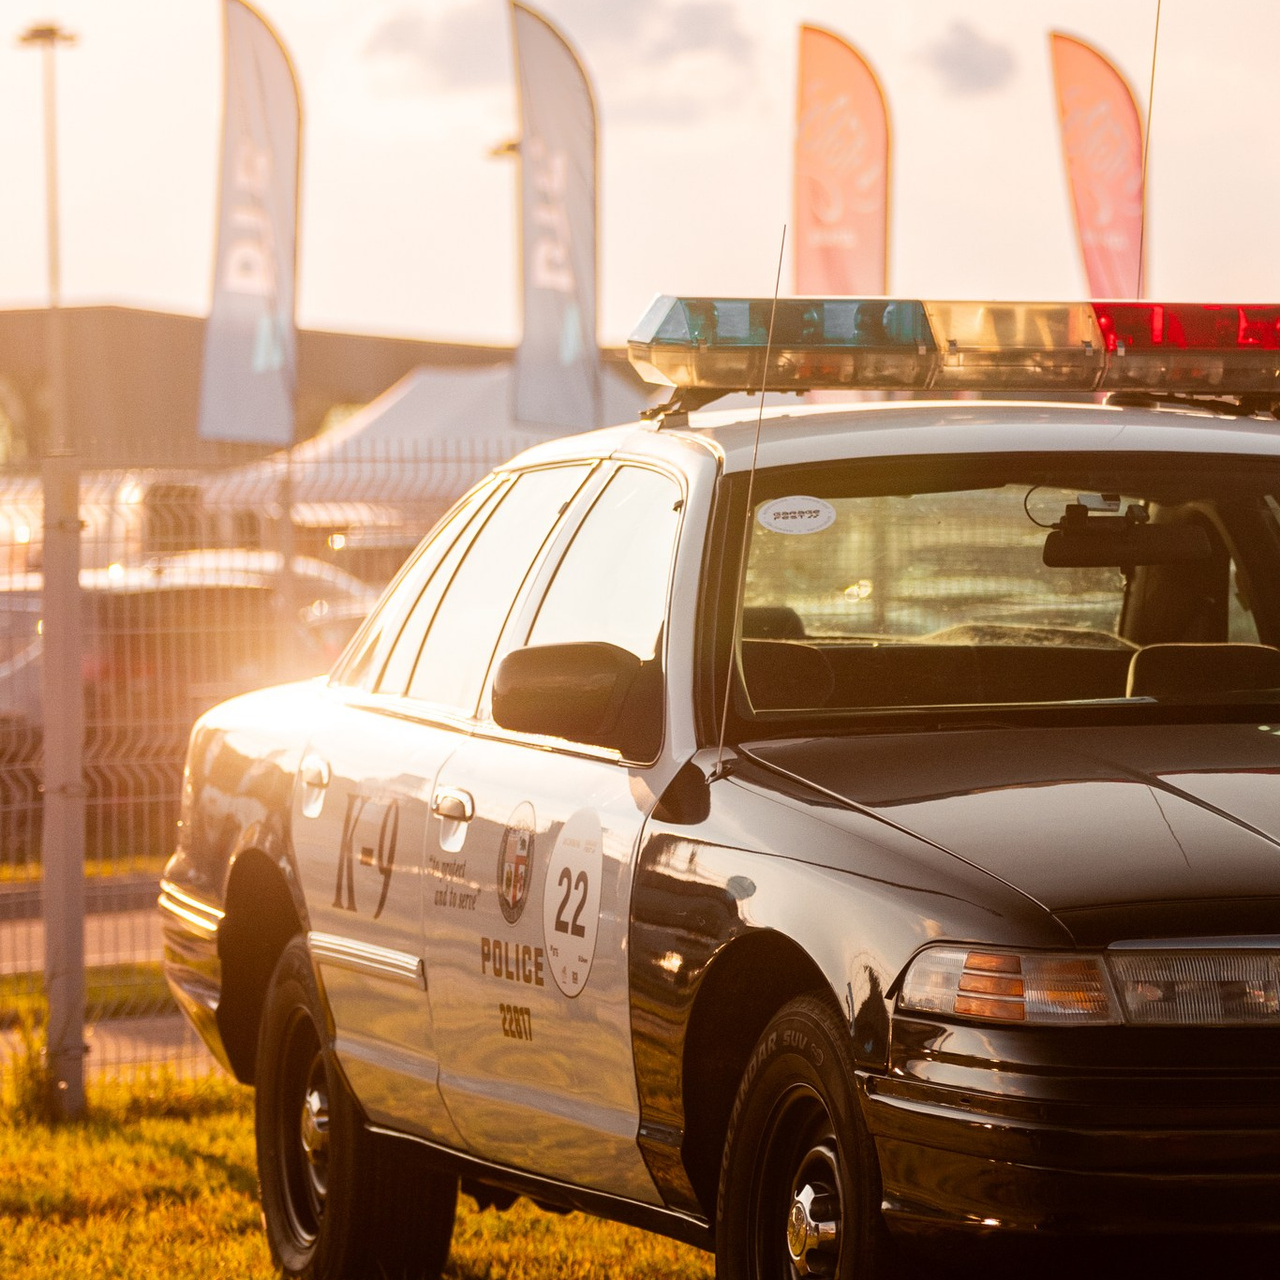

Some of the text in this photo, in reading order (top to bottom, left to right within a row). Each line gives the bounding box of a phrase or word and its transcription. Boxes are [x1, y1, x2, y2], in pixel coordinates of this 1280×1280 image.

[332, 793, 399, 920] K-9
[555, 867, 589, 938] 22
[481, 937, 544, 987] POLICE
[499, 1003, 532, 1041] 22817
[716, 1028, 808, 1222] GEOLANDAR SUV
